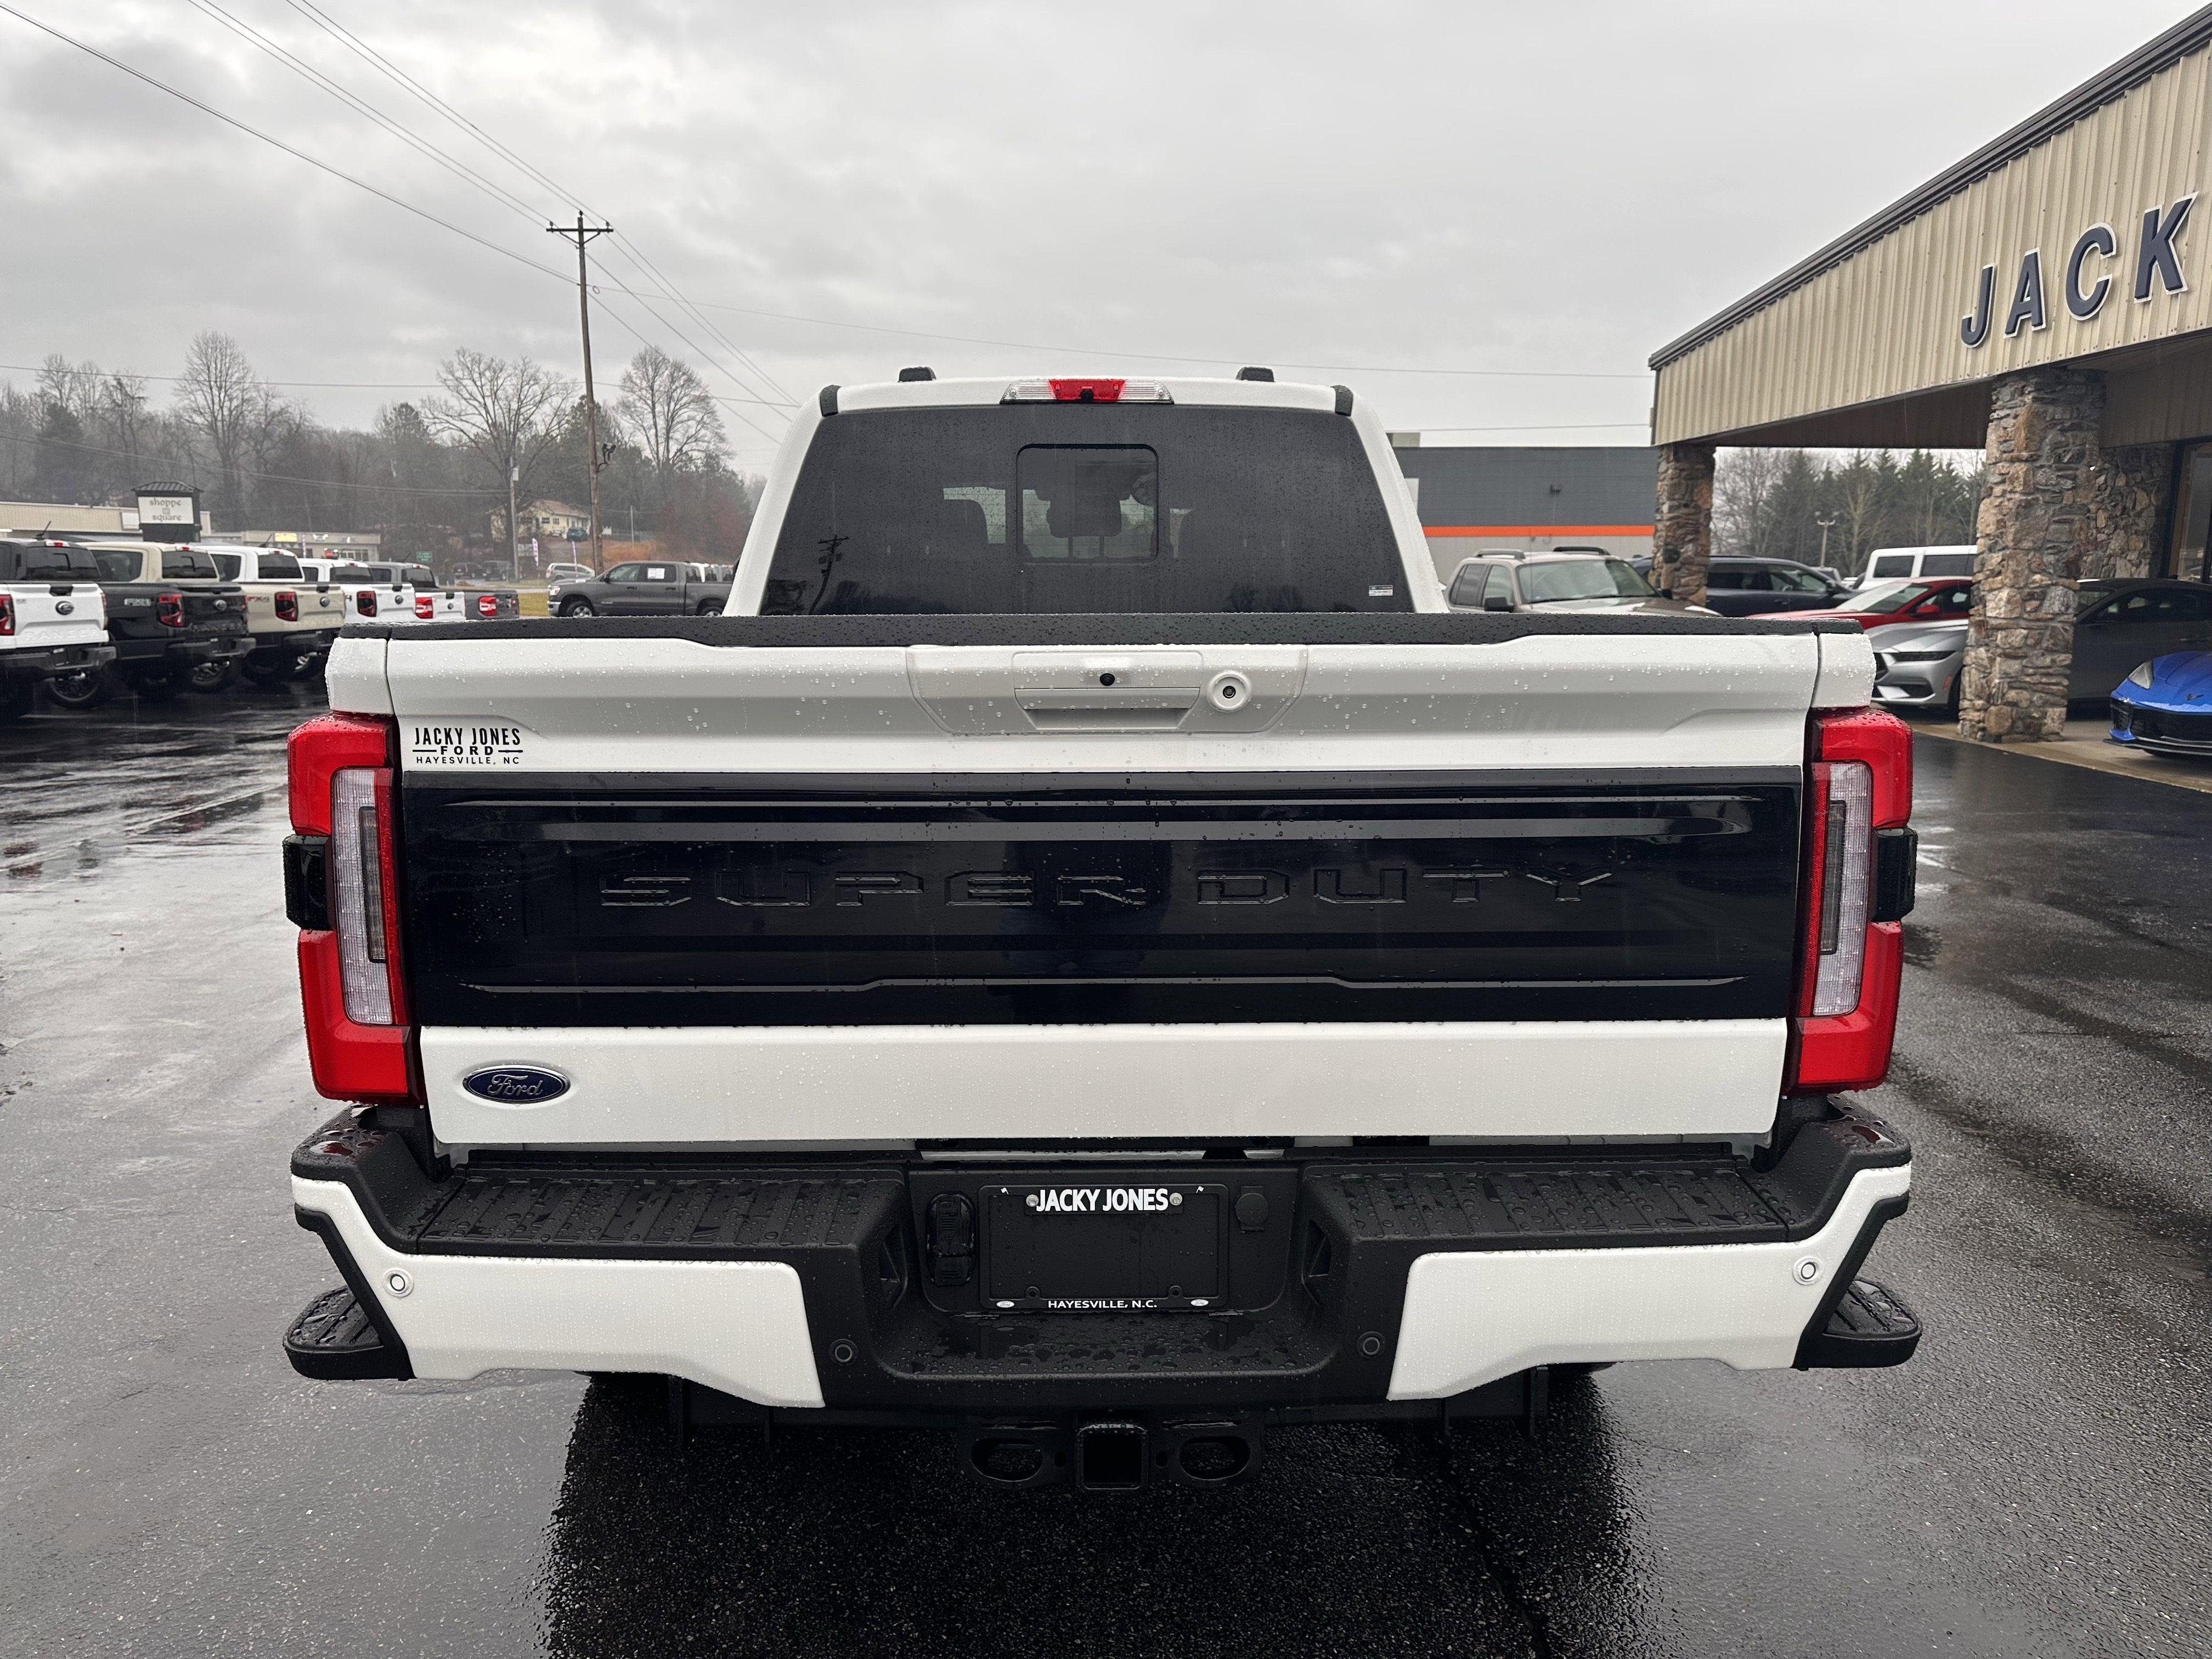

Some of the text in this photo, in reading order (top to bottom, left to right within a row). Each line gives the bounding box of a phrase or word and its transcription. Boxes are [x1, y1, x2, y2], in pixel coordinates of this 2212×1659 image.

[1961, 191, 2199, 349] JACK
[149, 498, 182, 508] shoppe
[152, 514, 182, 522] square
[415, 727, 521, 745] JACKY JONES
[441, 746, 493, 755] FORD
[416, 757, 496, 765] HAYESVILLE,
[600, 867, 1613, 908] SUPER DUTY
[487, 1074, 544, 1096] Ford
[1036, 1188, 1169, 1212] JACKY JONES
[1048, 1300, 1158, 1308] HAYESVILLE, N.C.
